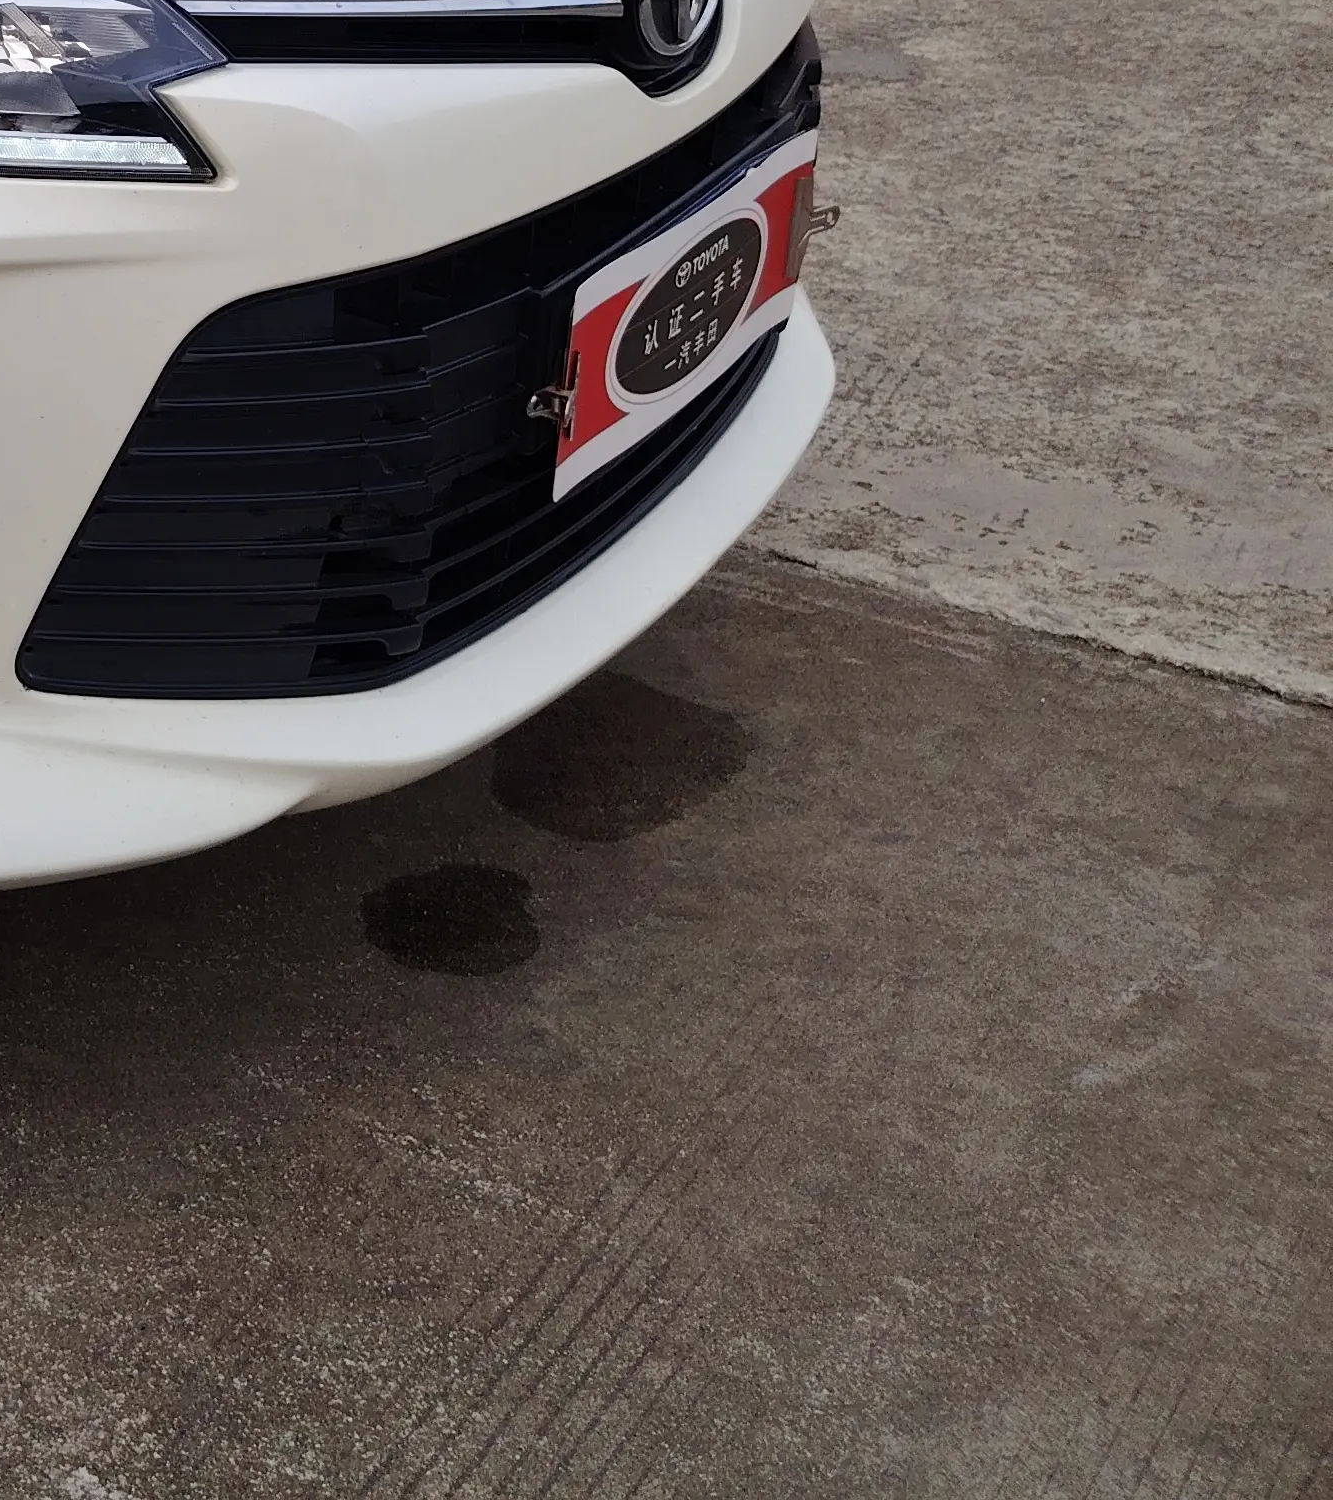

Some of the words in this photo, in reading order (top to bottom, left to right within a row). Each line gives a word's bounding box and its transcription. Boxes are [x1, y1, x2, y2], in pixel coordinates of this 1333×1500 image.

[692, 234, 729, 276] TOYOTA
[644, 257, 744, 356] 认证二手车
[664, 317, 719, 370] 一汽丰田
